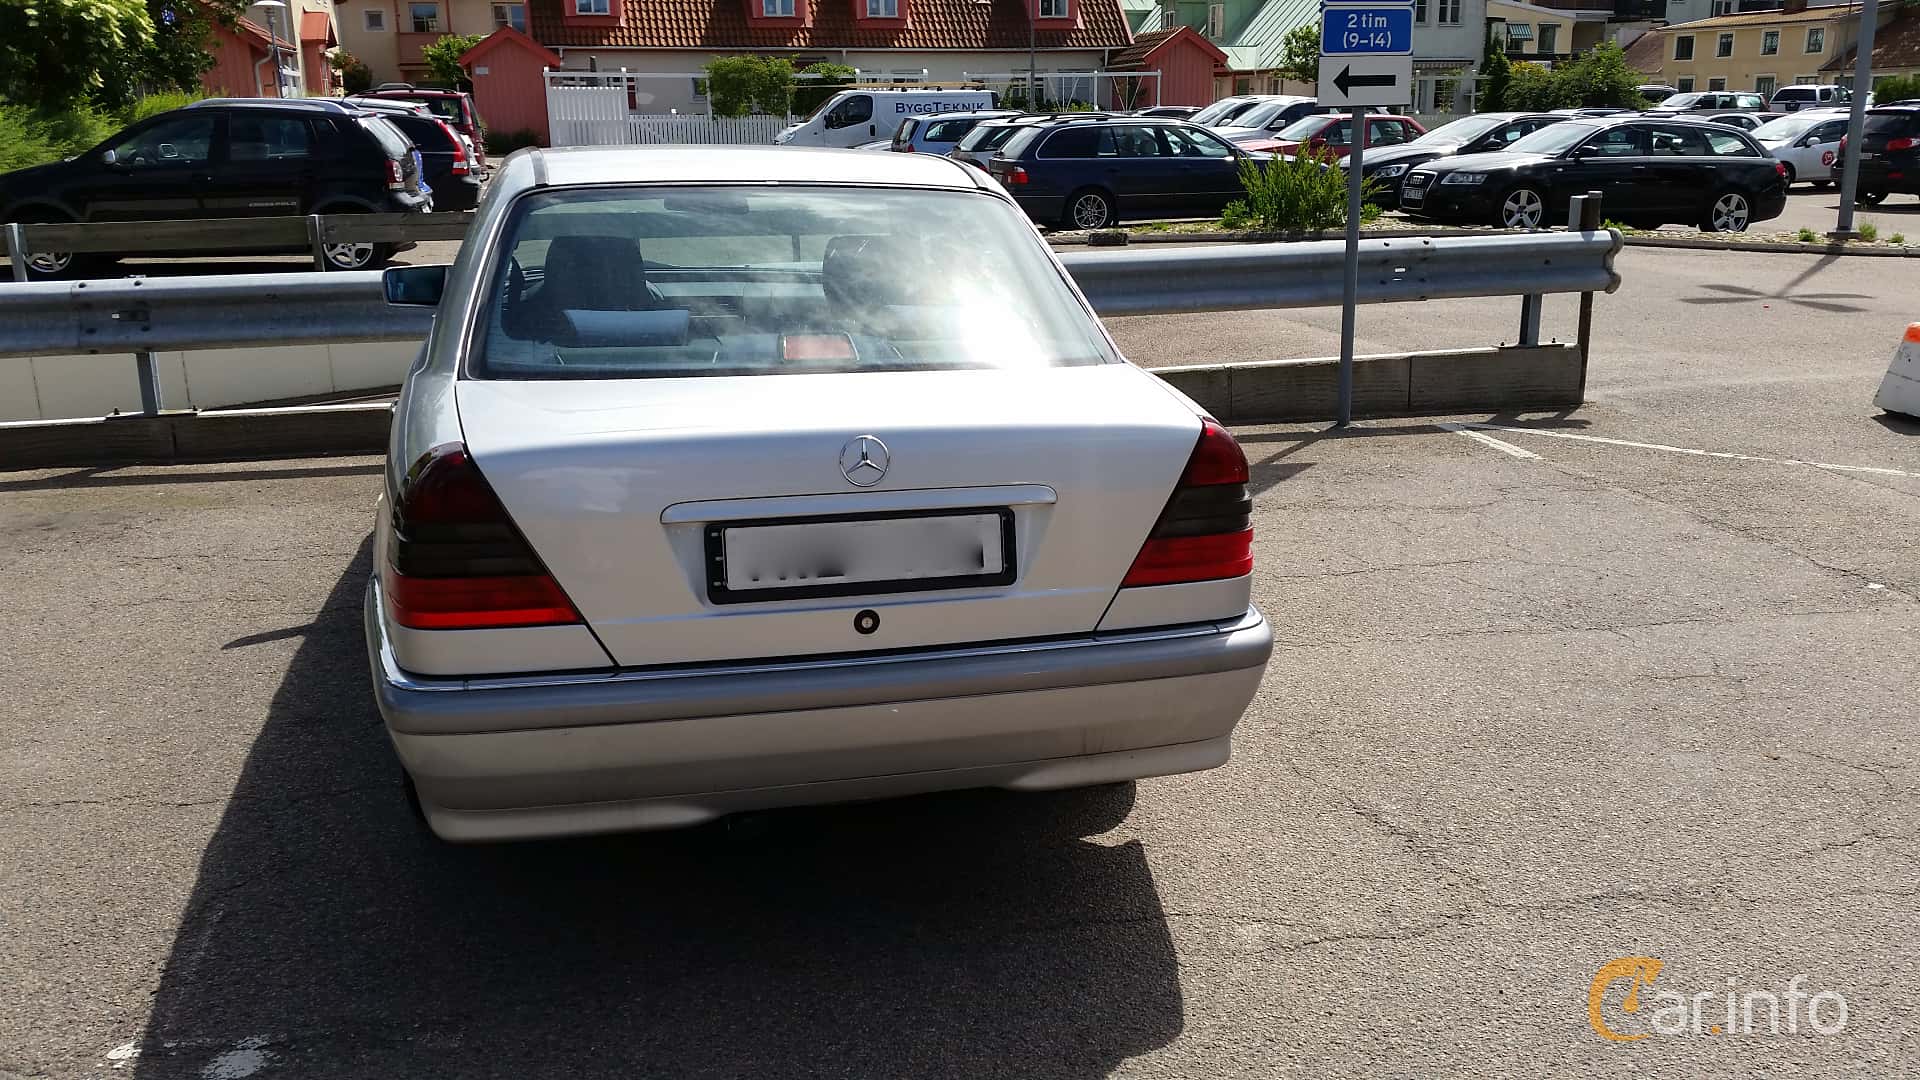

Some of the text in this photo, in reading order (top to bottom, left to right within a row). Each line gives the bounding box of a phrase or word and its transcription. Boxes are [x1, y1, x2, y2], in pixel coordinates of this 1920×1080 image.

[1347, 13, 1388, 29] 2 tim
[1343, 31, 1392, 49] (9-14)
